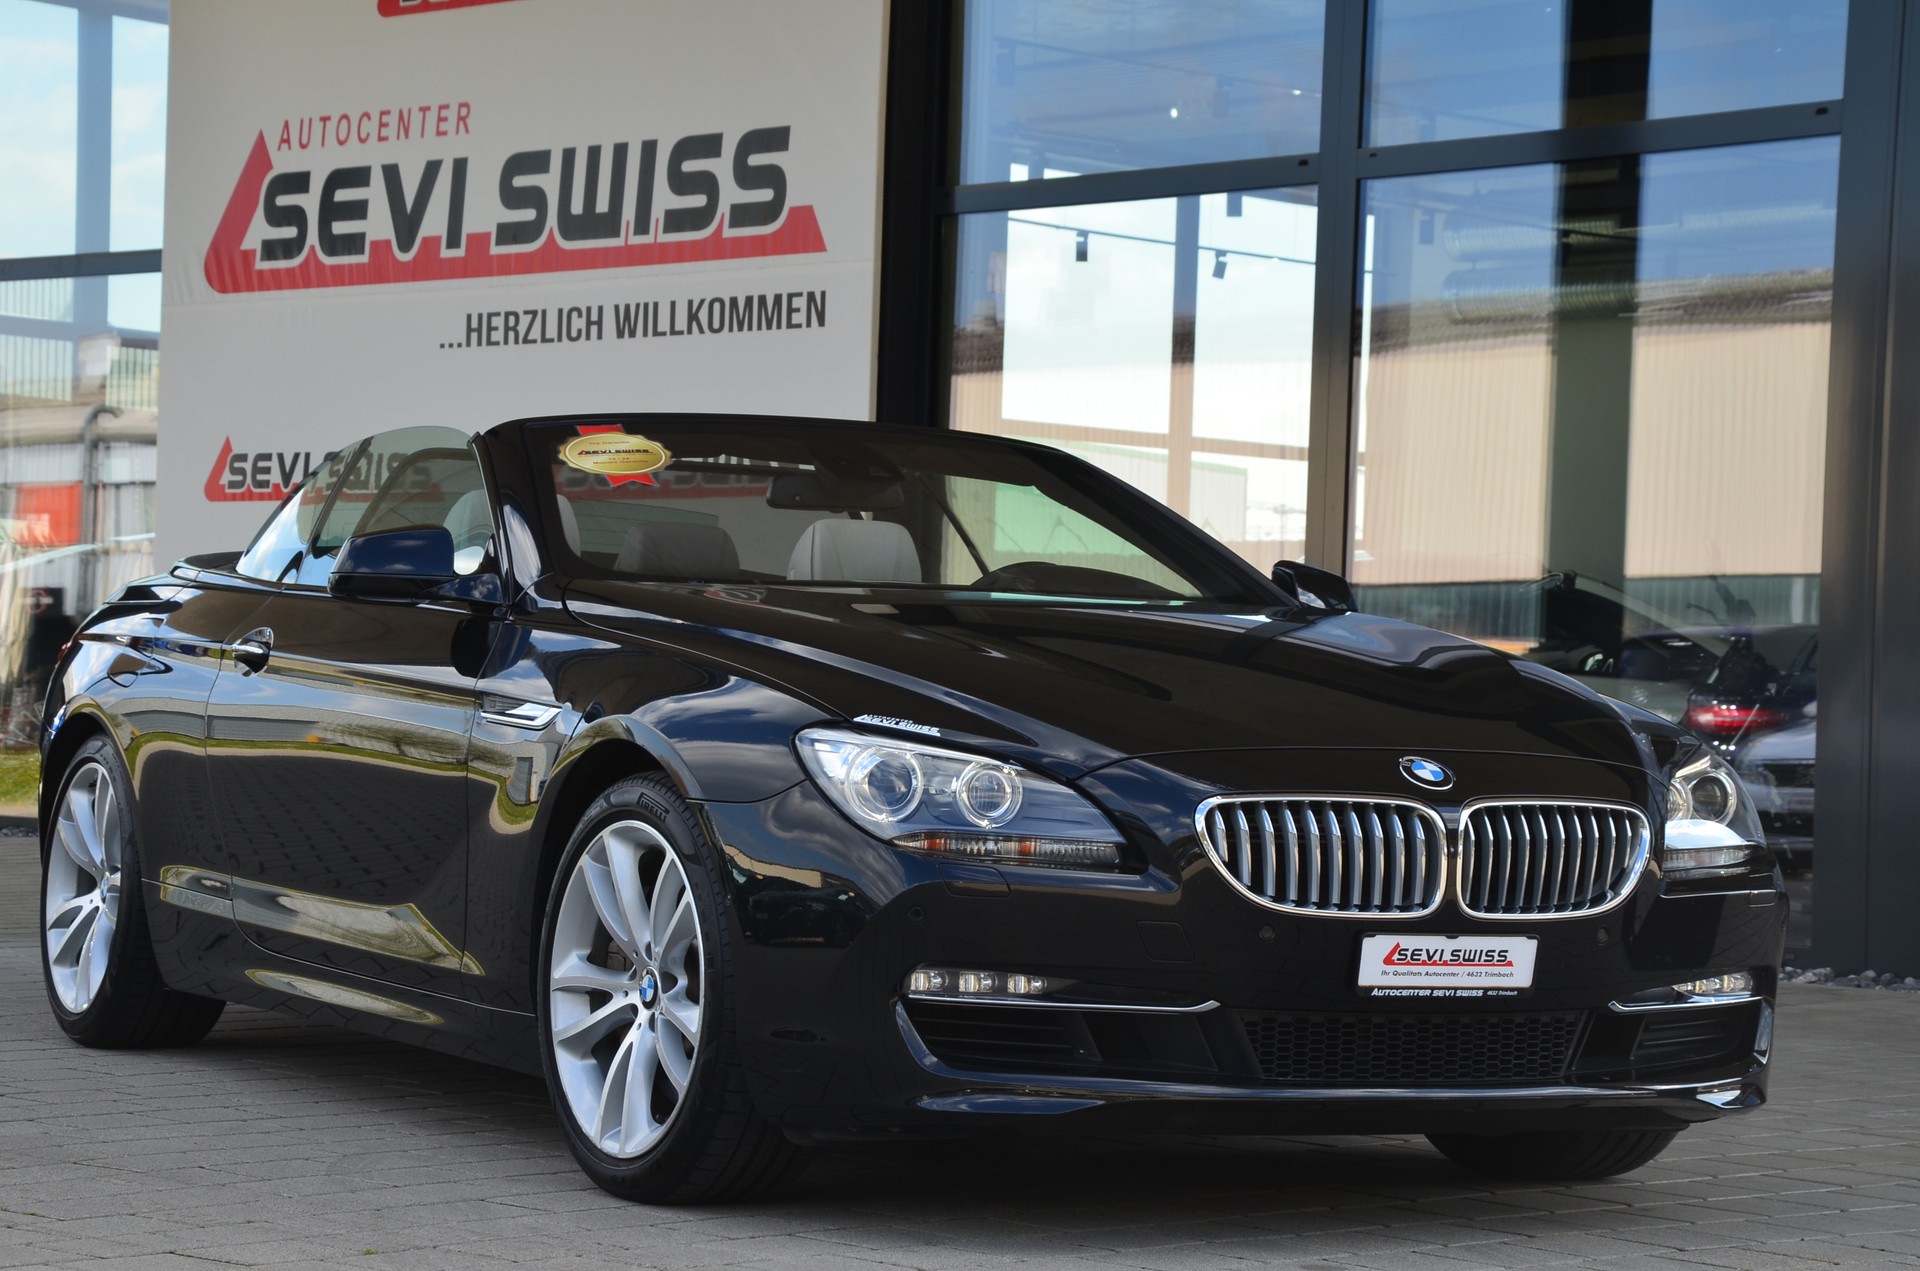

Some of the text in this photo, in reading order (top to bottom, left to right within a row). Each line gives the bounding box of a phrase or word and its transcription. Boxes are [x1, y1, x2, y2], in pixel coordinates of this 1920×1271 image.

[277, 102, 471, 151] AUTOCENTER
[260, 125, 791, 262] SEVI SWISS
[614, 290, 826, 340] WILLKOMMEN
[227, 452, 311, 490] SEVI
[864, 716, 940, 734] SEVI SWISS
[637, 792, 670, 823] PIRELLI
[1396, 948, 1509, 963] SEVI SWISS
[1371, 987, 1431, 997] AUTOCENTER
[1432, 989, 1454, 997] SEVI
[1455, 989, 1484, 997] SWISS
